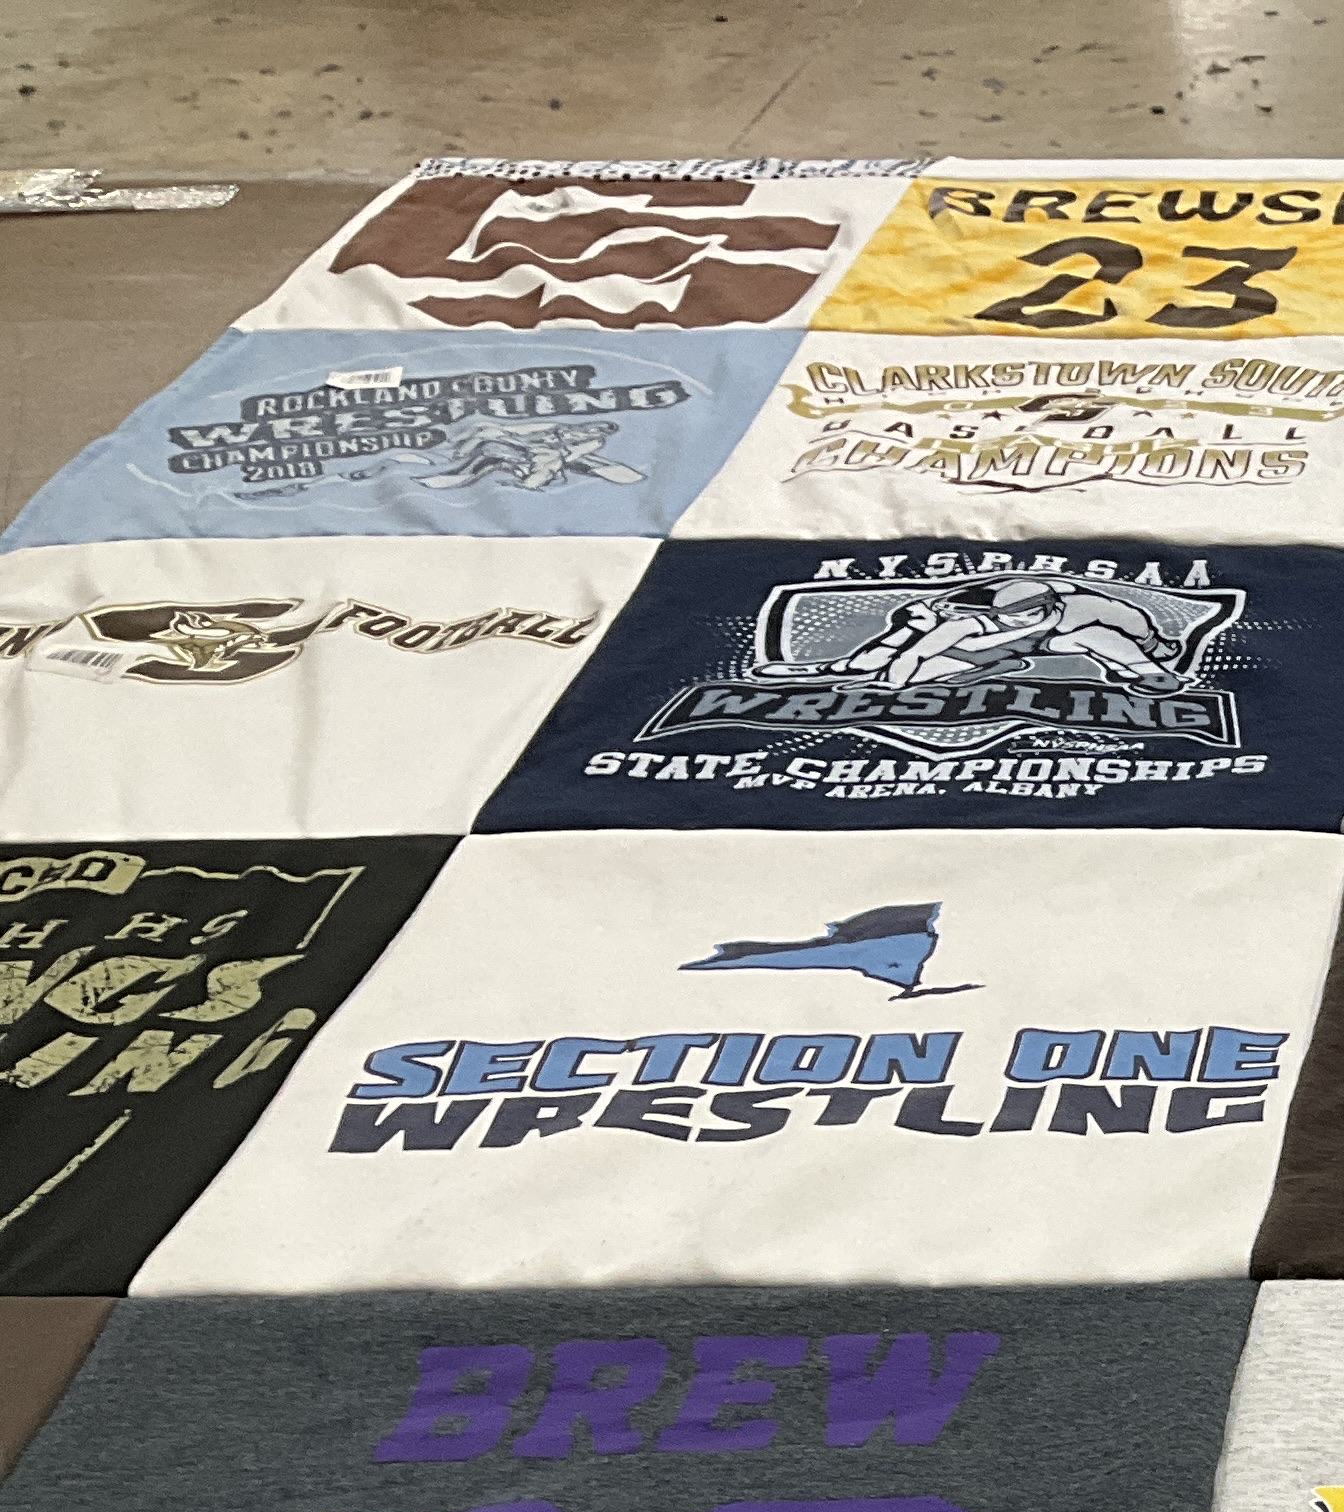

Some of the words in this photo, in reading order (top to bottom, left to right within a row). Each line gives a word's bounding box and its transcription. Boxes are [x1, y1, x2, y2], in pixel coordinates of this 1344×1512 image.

[973, 236, 1298, 328] 23
[806, 359, 1195, 395] CLARKSTOWN
[256, 381, 441, 418] ROCKLAND
[181, 431, 432, 472] CHAMPIONSHIP
[790, 440, 1309, 480] CHAMPIONS
[320, 598, 600, 654] FOOTBALL
[688, 684, 1213, 729] WRESTLING
[584, 748, 765, 781] STATE
[785, 752, 1269, 786] CHAMPIONSHIPS
[733, 772, 819, 791] MVP
[962, 780, 1104, 799] ALBANY
[352, 1030, 966, 1099] SECTION
[1004, 1026, 1291, 1084] ONE
[326, 1083, 1277, 1154] WRESTLING
[371, 1331, 1002, 1464] BREW
